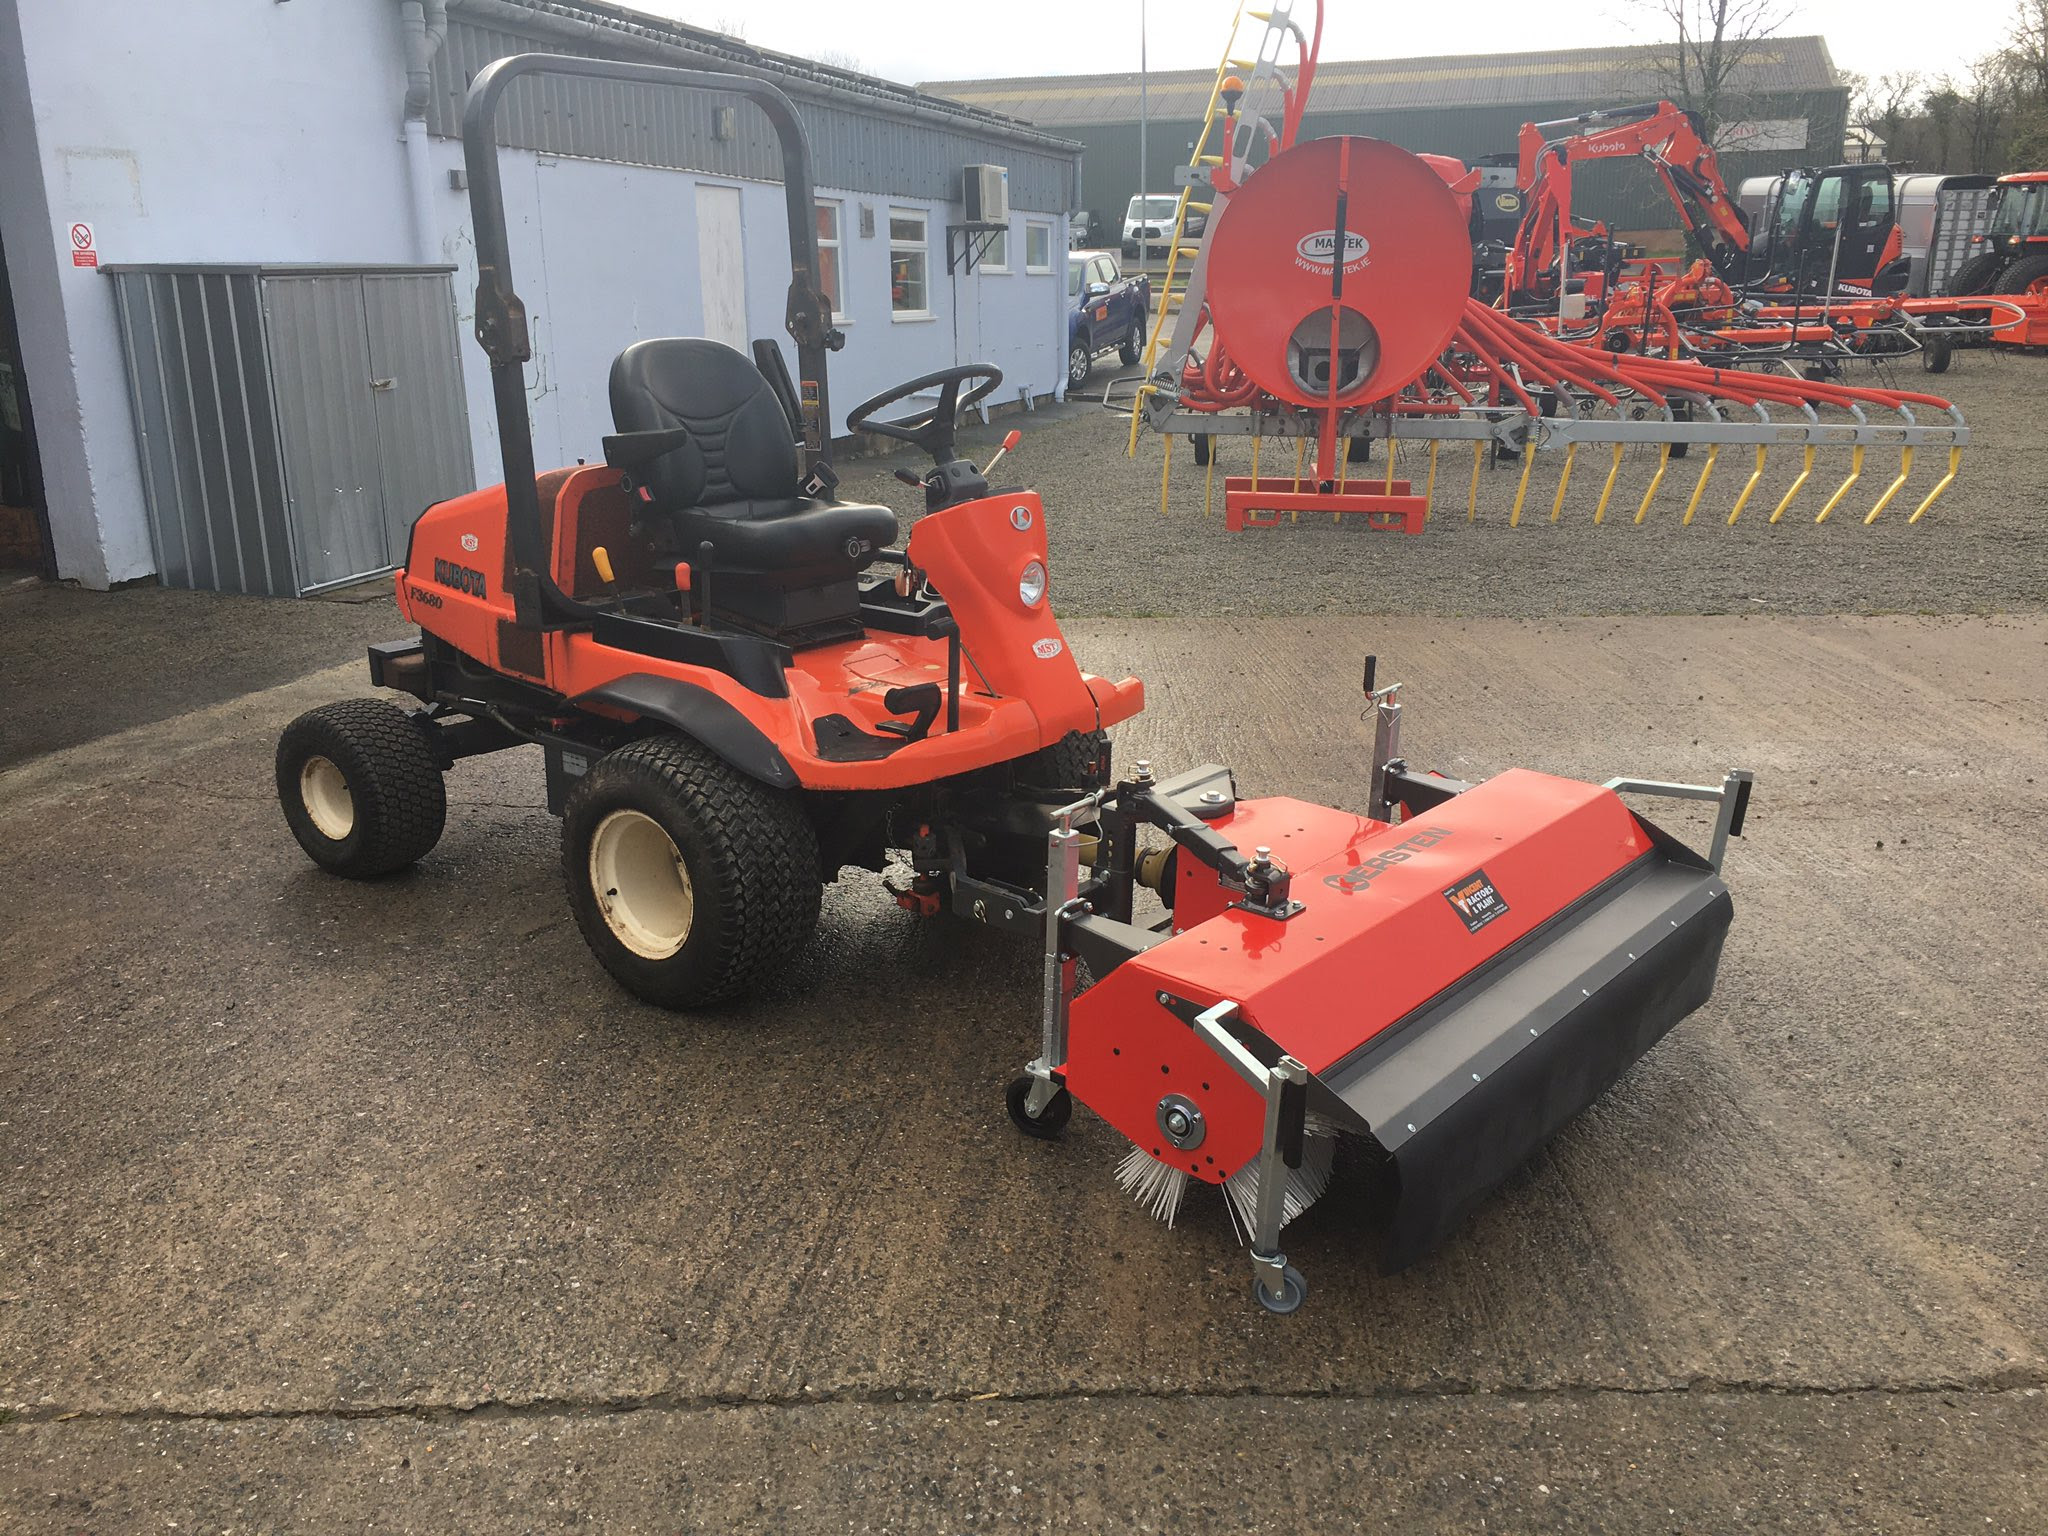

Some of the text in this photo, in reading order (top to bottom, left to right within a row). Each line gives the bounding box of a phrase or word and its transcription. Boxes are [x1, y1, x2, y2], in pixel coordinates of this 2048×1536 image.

[1588, 142, 1626, 153] Kubota
[1315, 238, 1364, 249] MATEK
[1295, 256, 1371, 276] WWW.MATEK.IE
[1838, 282, 1872, 297] KUBOTA
[434, 557, 487, 600] KUBOTA
[411, 586, 443, 609] F3680
[1037, 642, 1056, 654] MST
[1476, 895, 1495, 911] PLANT
